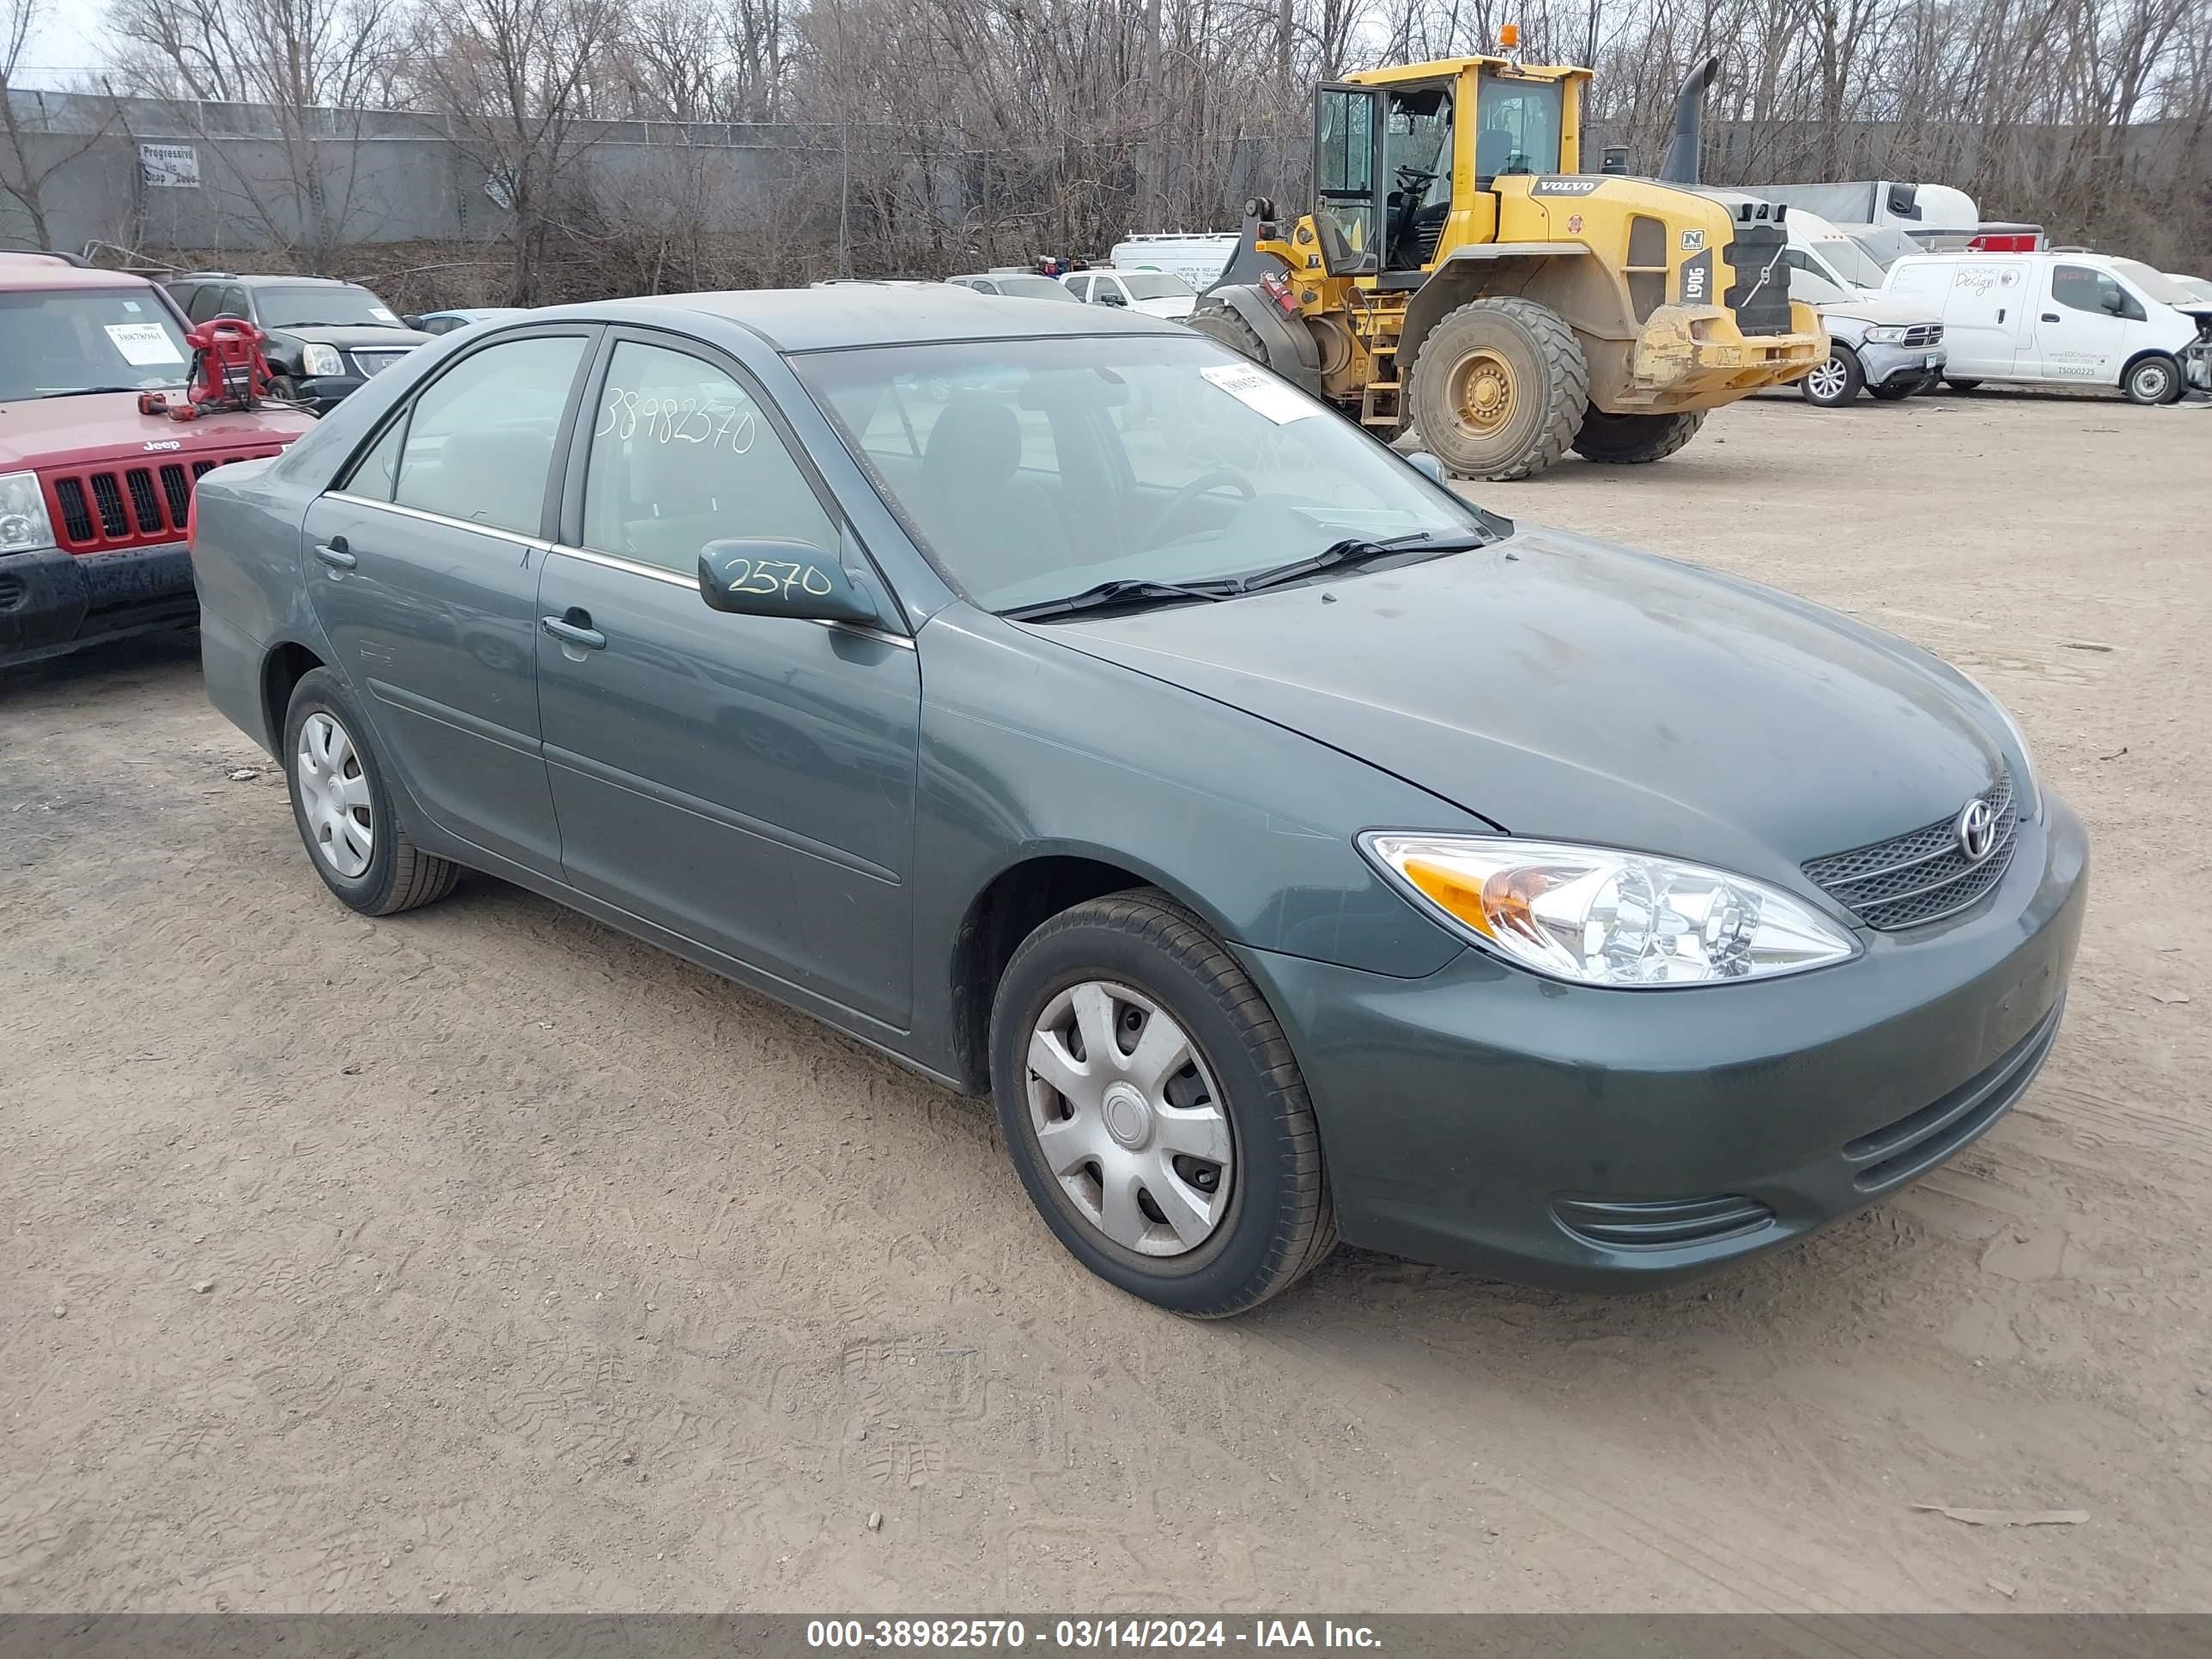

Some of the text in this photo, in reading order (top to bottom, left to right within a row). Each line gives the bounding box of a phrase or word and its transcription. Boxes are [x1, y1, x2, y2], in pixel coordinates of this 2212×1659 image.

[143, 146, 193, 160] Progressive
[1540, 181, 1595, 191] VOLVO
[1686, 267, 1705, 298] L90G
[1955, 273, 1994, 297] Design
[2058, 367, 2095, 375] TS000225
[597, 388, 756, 454] 38982570
[143, 441, 180, 451] Jeep
[725, 558, 832, 601] 2570
